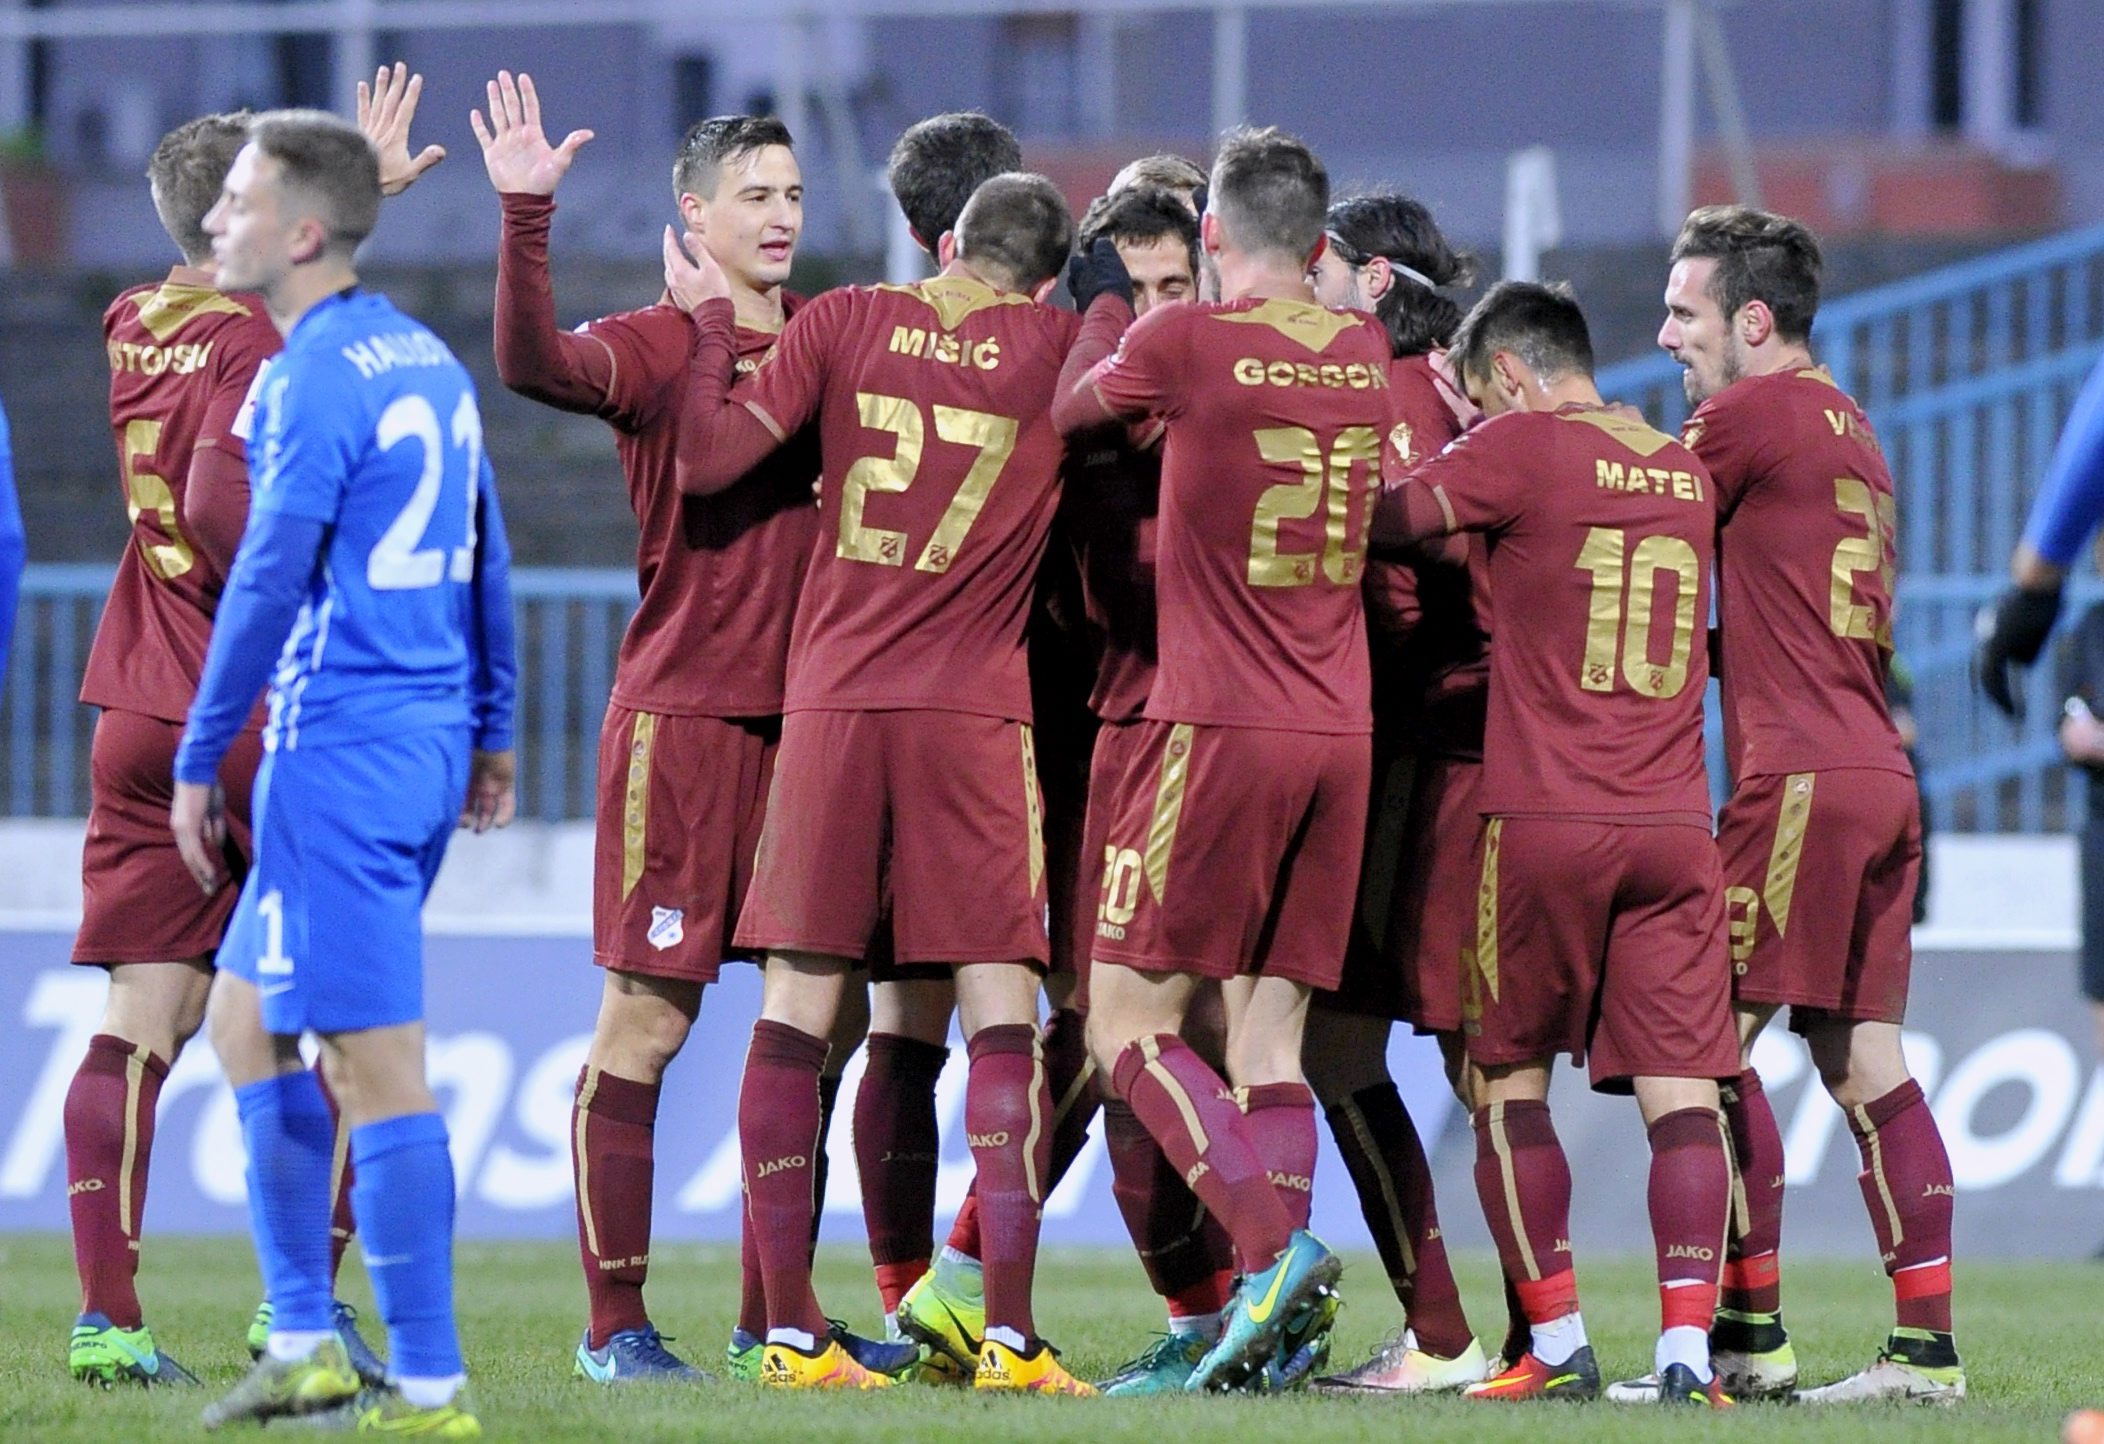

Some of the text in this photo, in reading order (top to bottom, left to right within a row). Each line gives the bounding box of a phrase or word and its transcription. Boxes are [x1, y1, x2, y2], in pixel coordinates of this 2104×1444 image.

[889, 325, 1000, 370] MIŠIĆ
[1233, 357, 1390, 390] GORDON
[125, 419, 194, 579] 5
[367, 391, 483, 590] 21
[836, 392, 1019, 574] 27
[1247, 426, 1383, 587] 20
[1595, 459, 1704, 502] MATEI
[1573, 526, 1699, 699] 10
[257, 889, 295, 974] 1
[757, 1154, 806, 1178] JAKO
[1665, 1244, 1714, 1261] JAKO
